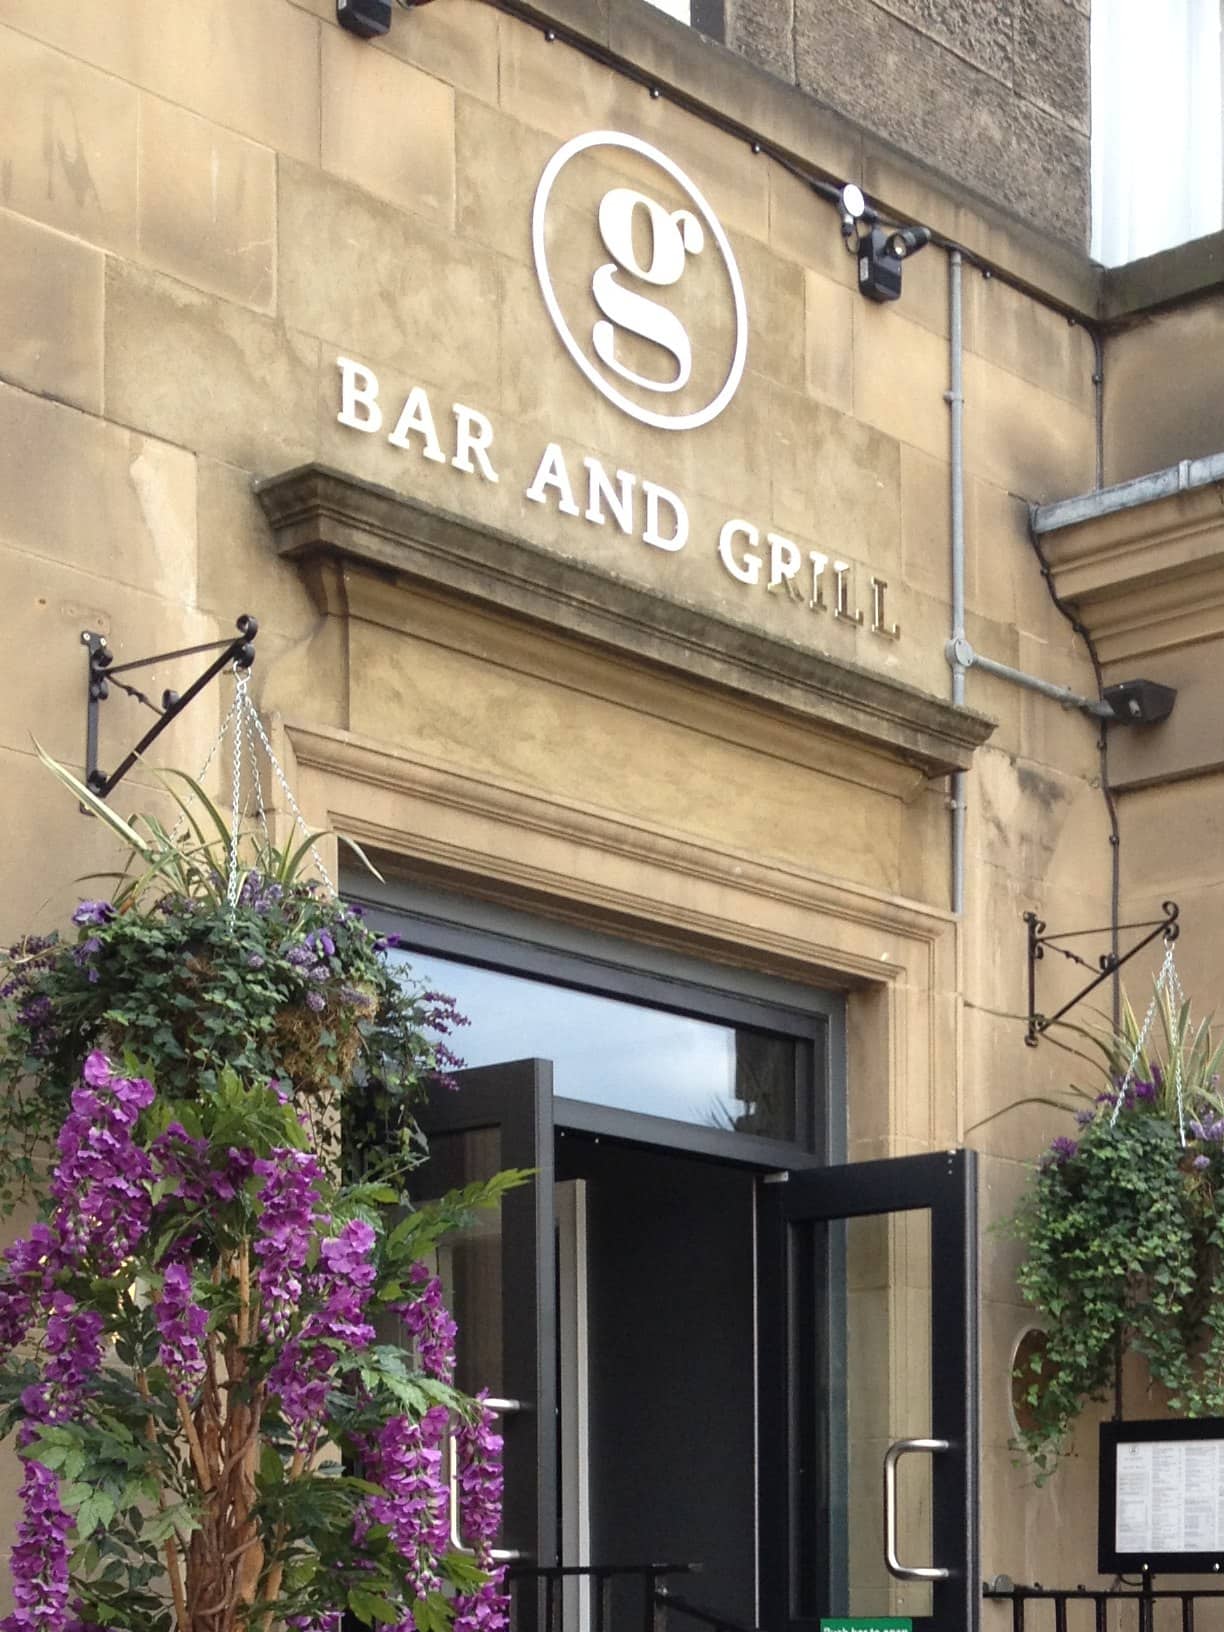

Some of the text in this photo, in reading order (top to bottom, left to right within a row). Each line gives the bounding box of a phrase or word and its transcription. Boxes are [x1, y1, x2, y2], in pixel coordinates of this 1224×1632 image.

[592, 188, 704, 392] g
[336, 356, 901, 640] BAR AND GRILL
